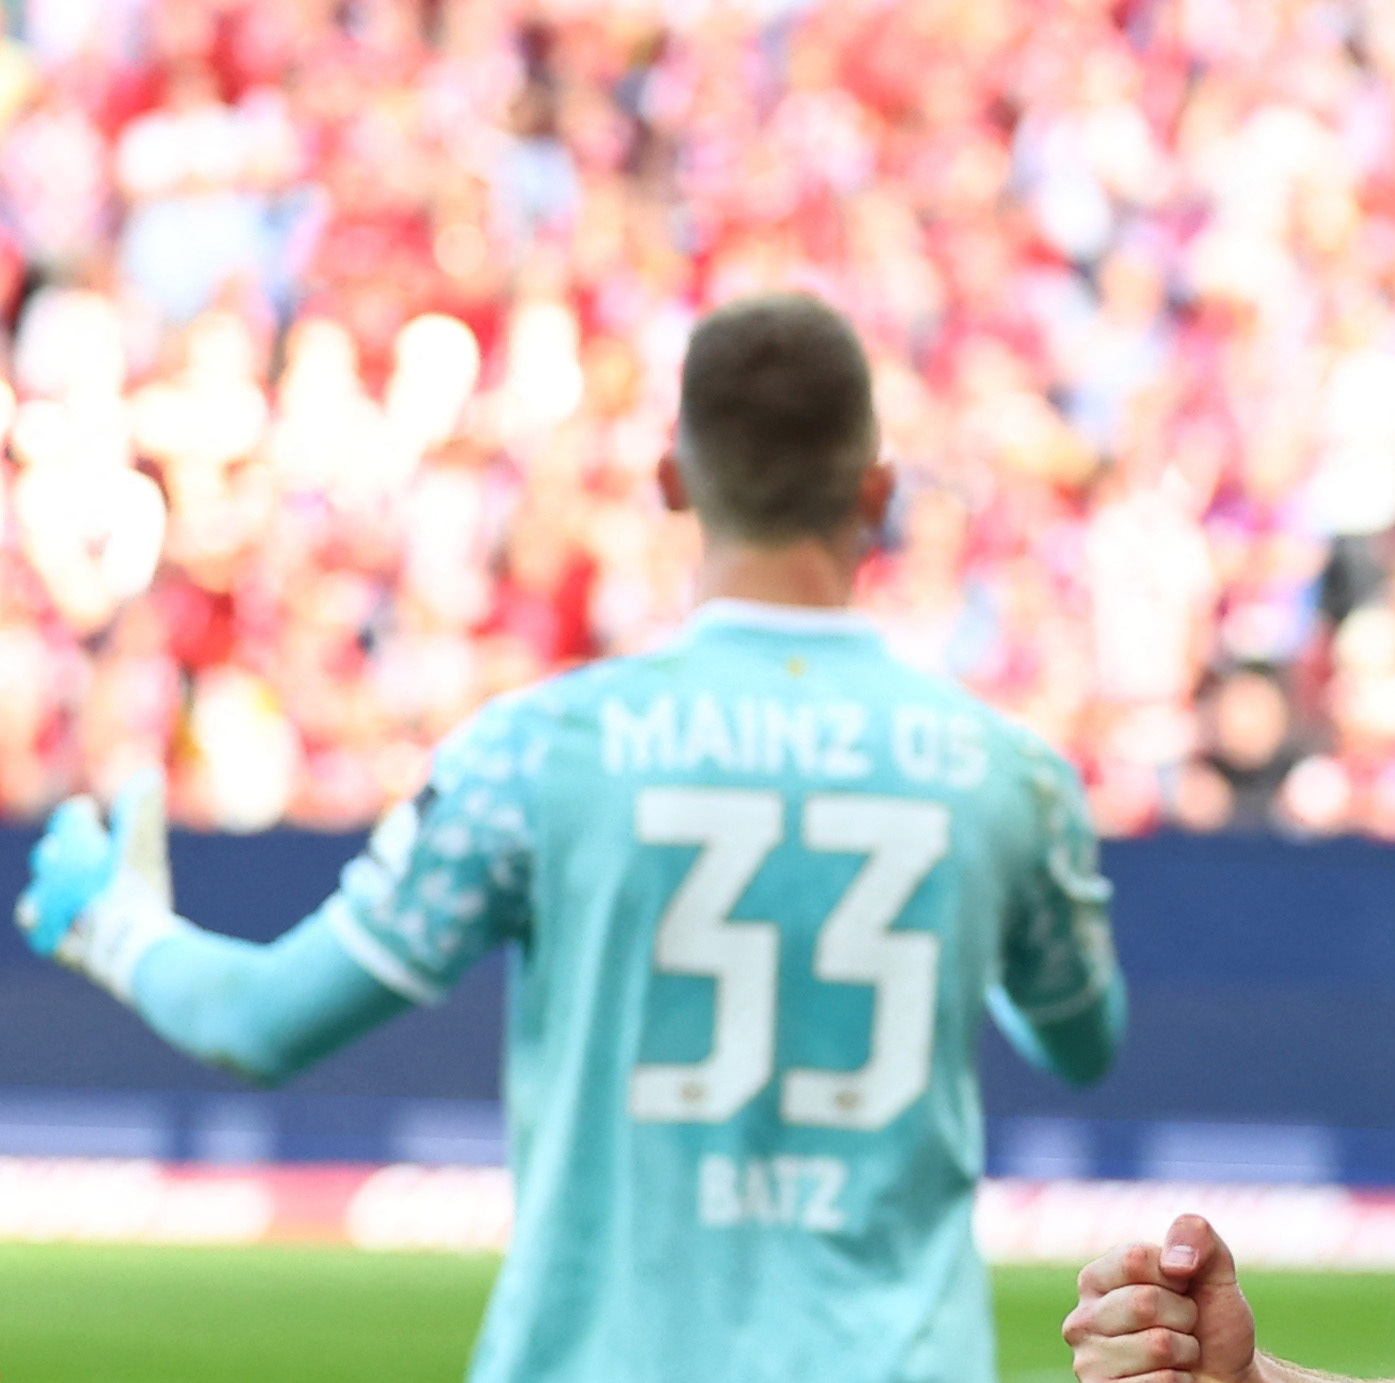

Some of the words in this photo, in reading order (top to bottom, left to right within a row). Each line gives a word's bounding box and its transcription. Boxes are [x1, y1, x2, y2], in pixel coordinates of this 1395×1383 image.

[602, 692, 871, 778] MAINZ
[893, 706, 989, 788] 05
[629, 785, 951, 1131] 33
[697, 1153, 852, 1233] BATZ
